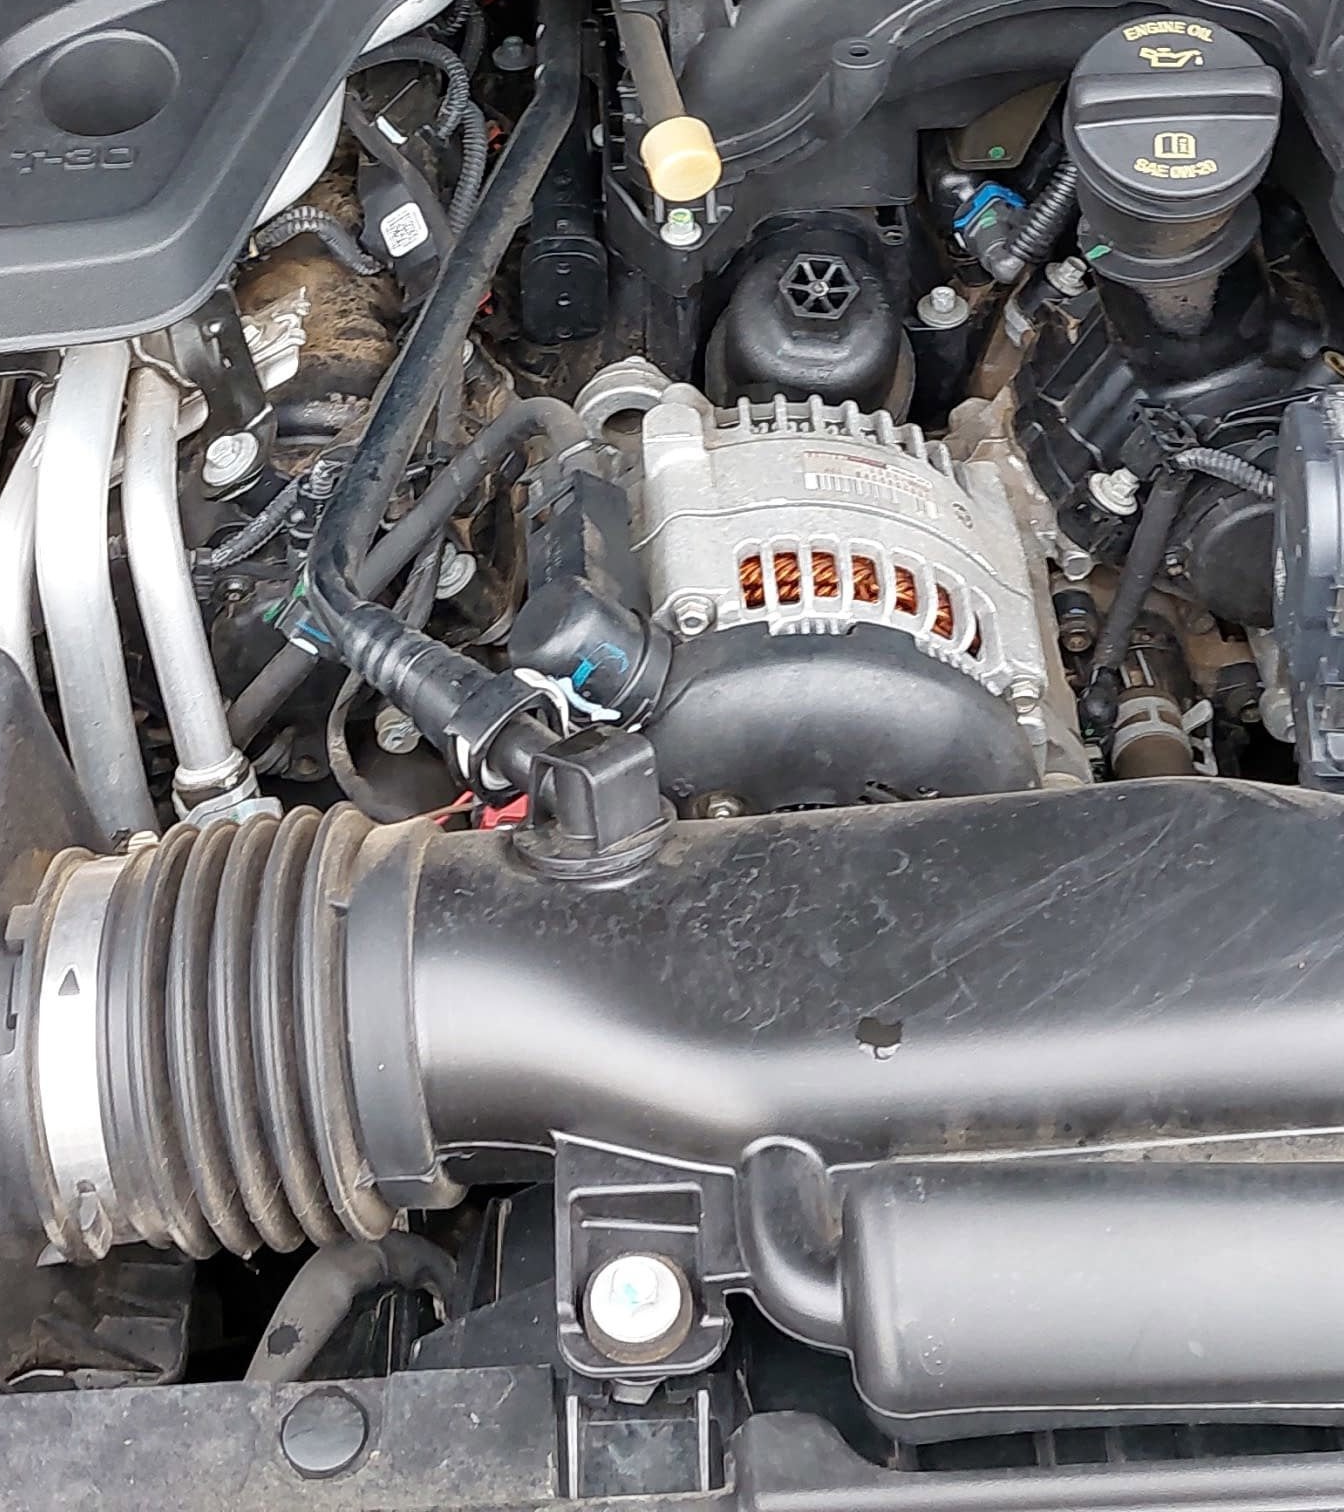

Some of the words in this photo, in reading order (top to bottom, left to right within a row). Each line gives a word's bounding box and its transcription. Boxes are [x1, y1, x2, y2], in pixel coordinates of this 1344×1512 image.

[1123, 21, 1186, 42] ENGINE
[1187, 23, 1214, 43] OIL
[1134, 158, 1169, 178] SAE
